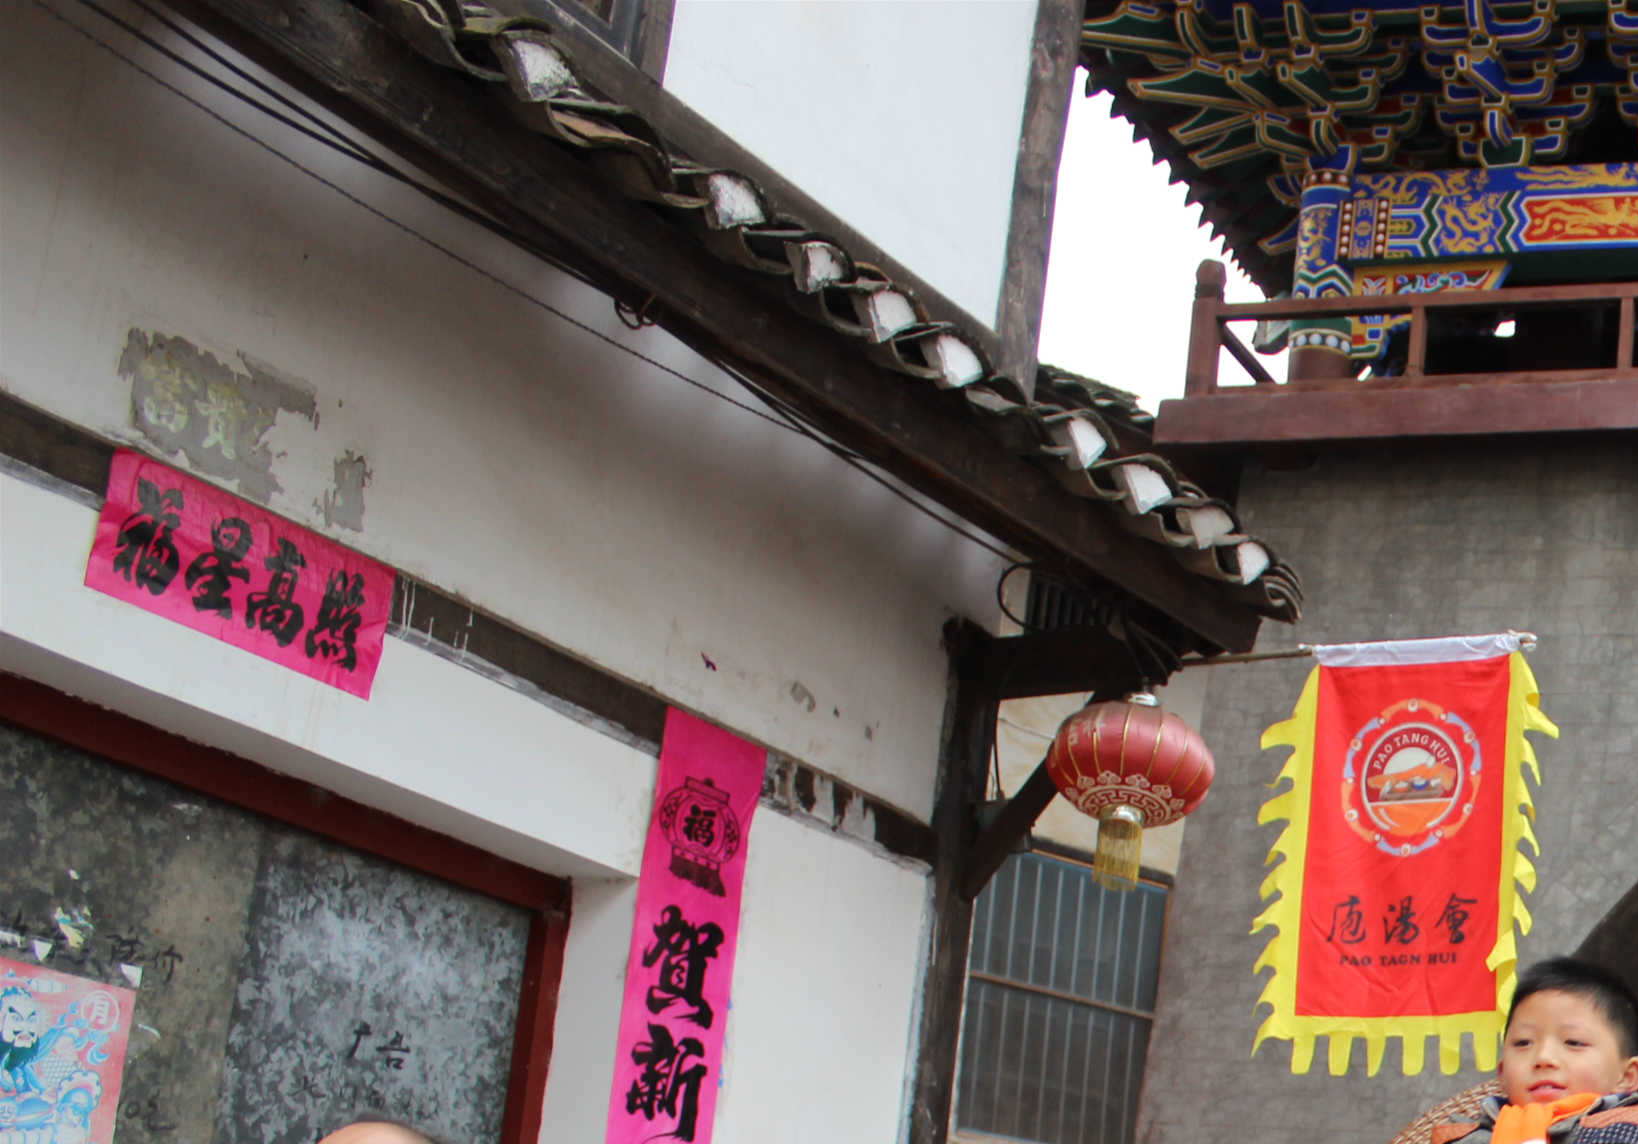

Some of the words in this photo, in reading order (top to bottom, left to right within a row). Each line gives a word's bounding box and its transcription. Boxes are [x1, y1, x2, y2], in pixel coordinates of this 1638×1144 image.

[113, 476, 366, 673] 福星高照
[1372, 743, 1394, 770] PAO
[1393, 732, 1430, 749] TANG
[1429, 740, 1451, 765] HUI
[682, 804, 717, 848] 福
[1340, 954, 1373, 967] PAO
[1379, 954, 1421, 967] TAGN
[1427, 952, 1457, 965] HUI
